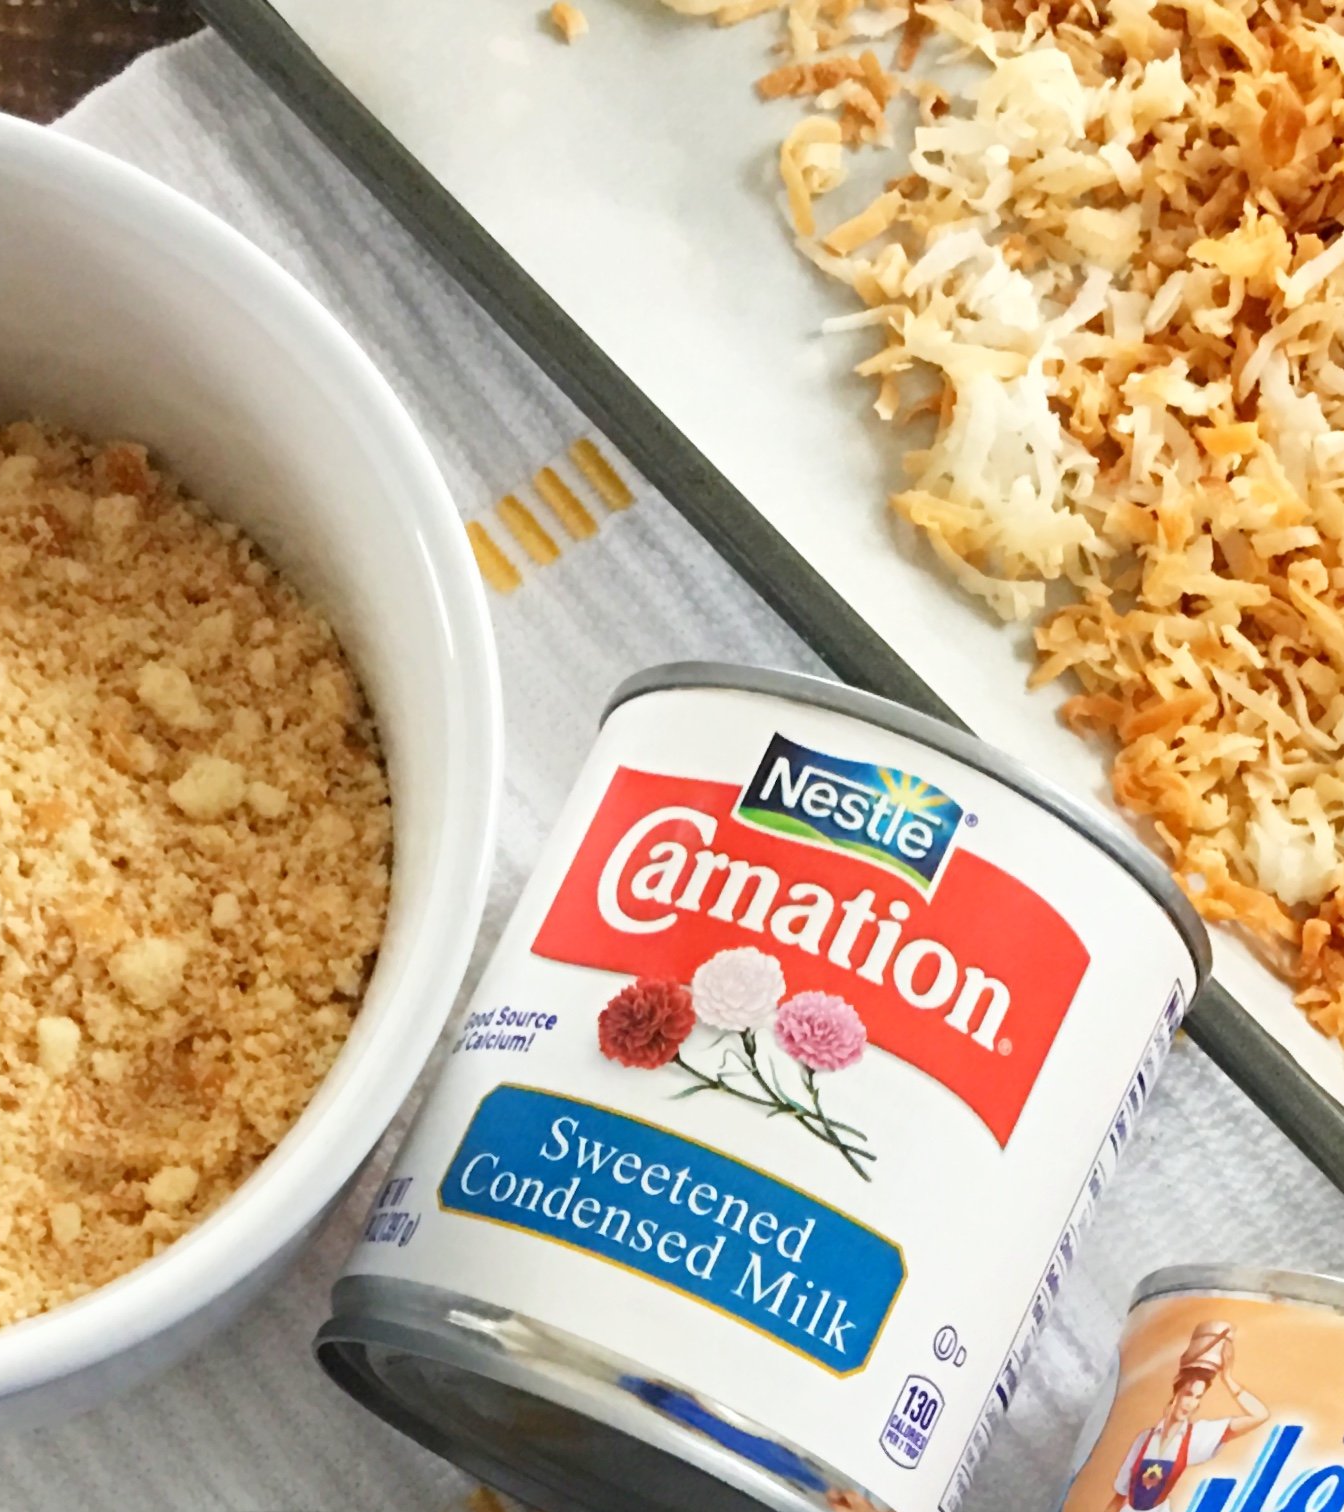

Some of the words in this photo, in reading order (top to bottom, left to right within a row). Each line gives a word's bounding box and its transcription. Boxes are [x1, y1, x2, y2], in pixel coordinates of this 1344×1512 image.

[597, 806, 1011, 1052] Carnation
[465, 1031, 536, 1052] Calcium!
[496, 1006, 558, 1030] Source
[539, 1115, 816, 1263] Sweetened
[460, 1152, 727, 1280] Condensed
[730, 1251, 857, 1355] Milk
[902, 1385, 938, 1431] 130
